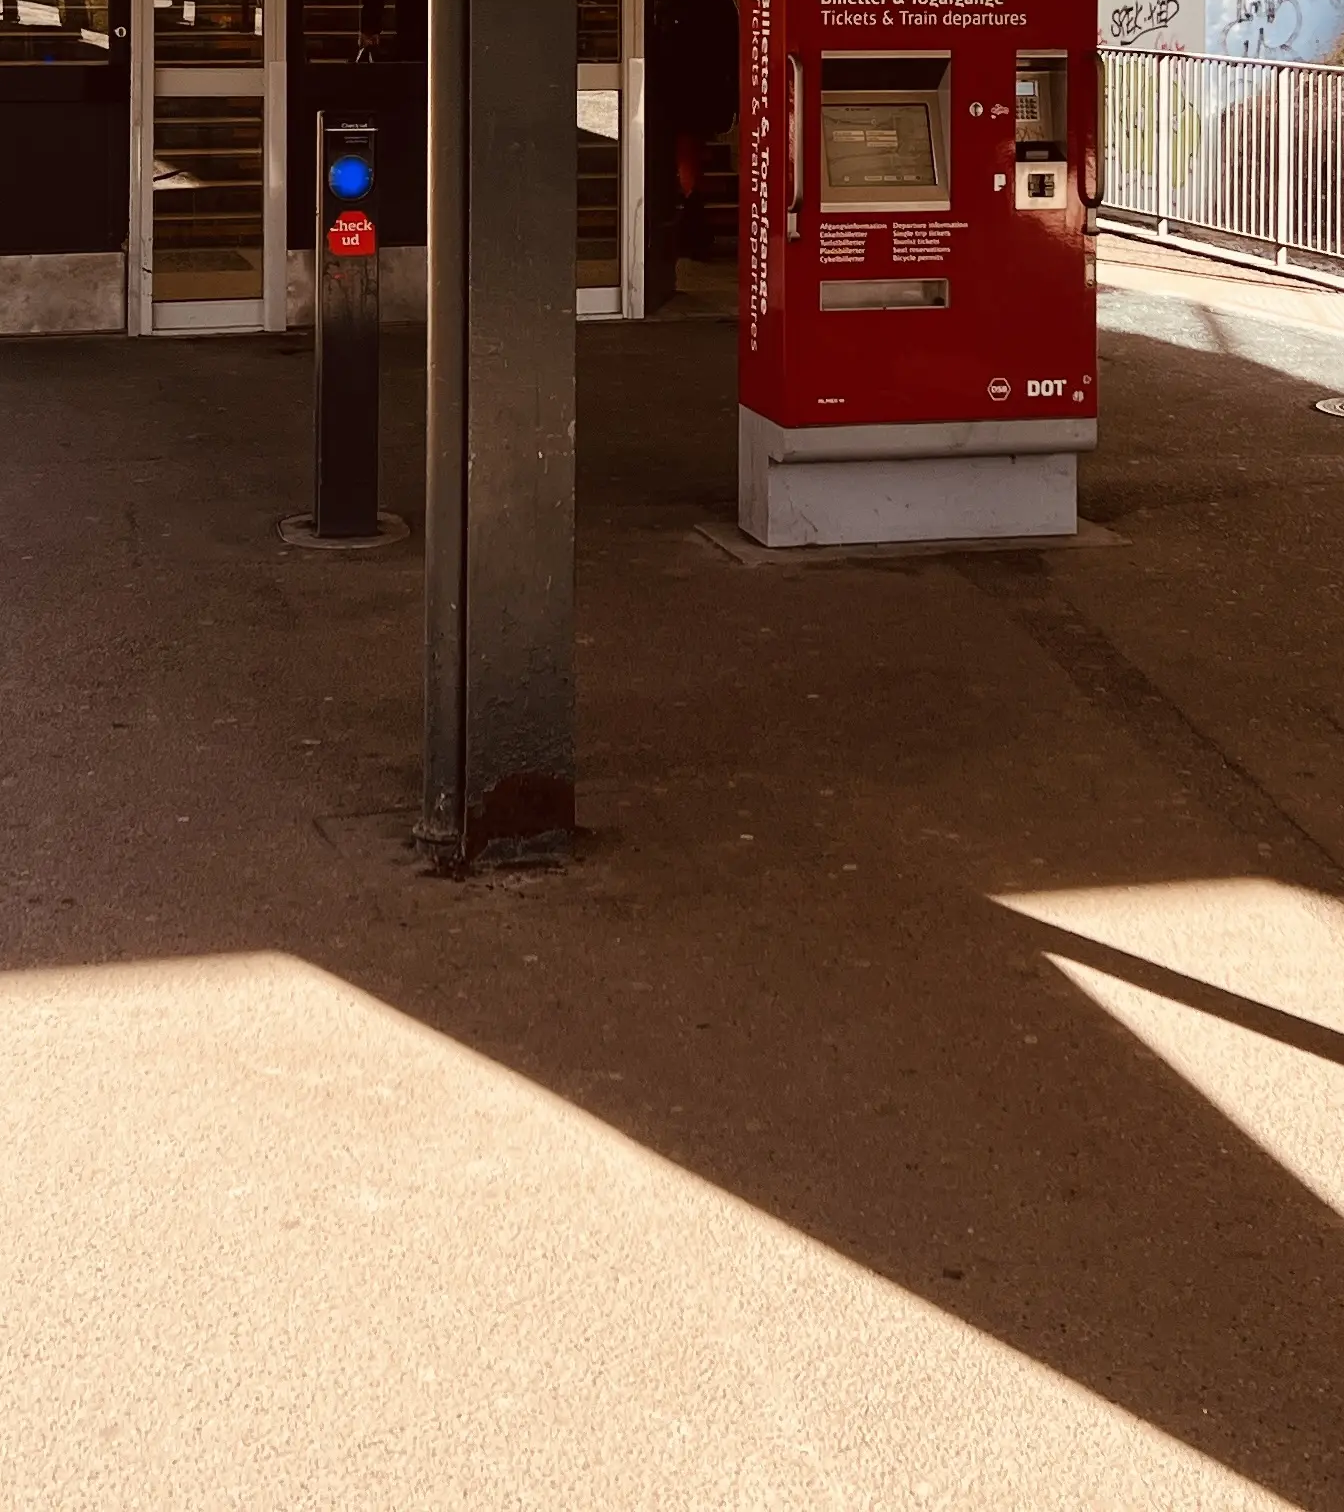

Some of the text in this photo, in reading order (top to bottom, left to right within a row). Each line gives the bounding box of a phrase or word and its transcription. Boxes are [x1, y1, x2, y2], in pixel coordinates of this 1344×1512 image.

[821, 10, 1027, 28] Tickets & Train departures
[751, 96, 760, 115] &
[759, 116, 770, 138] &
[750, 127, 760, 192] Train
[342, 233, 360, 246] ud
[758, 147, 770, 316] Togafgange
[749, 202, 759, 351] departures
[1027, 379, 1067, 397] DOT
